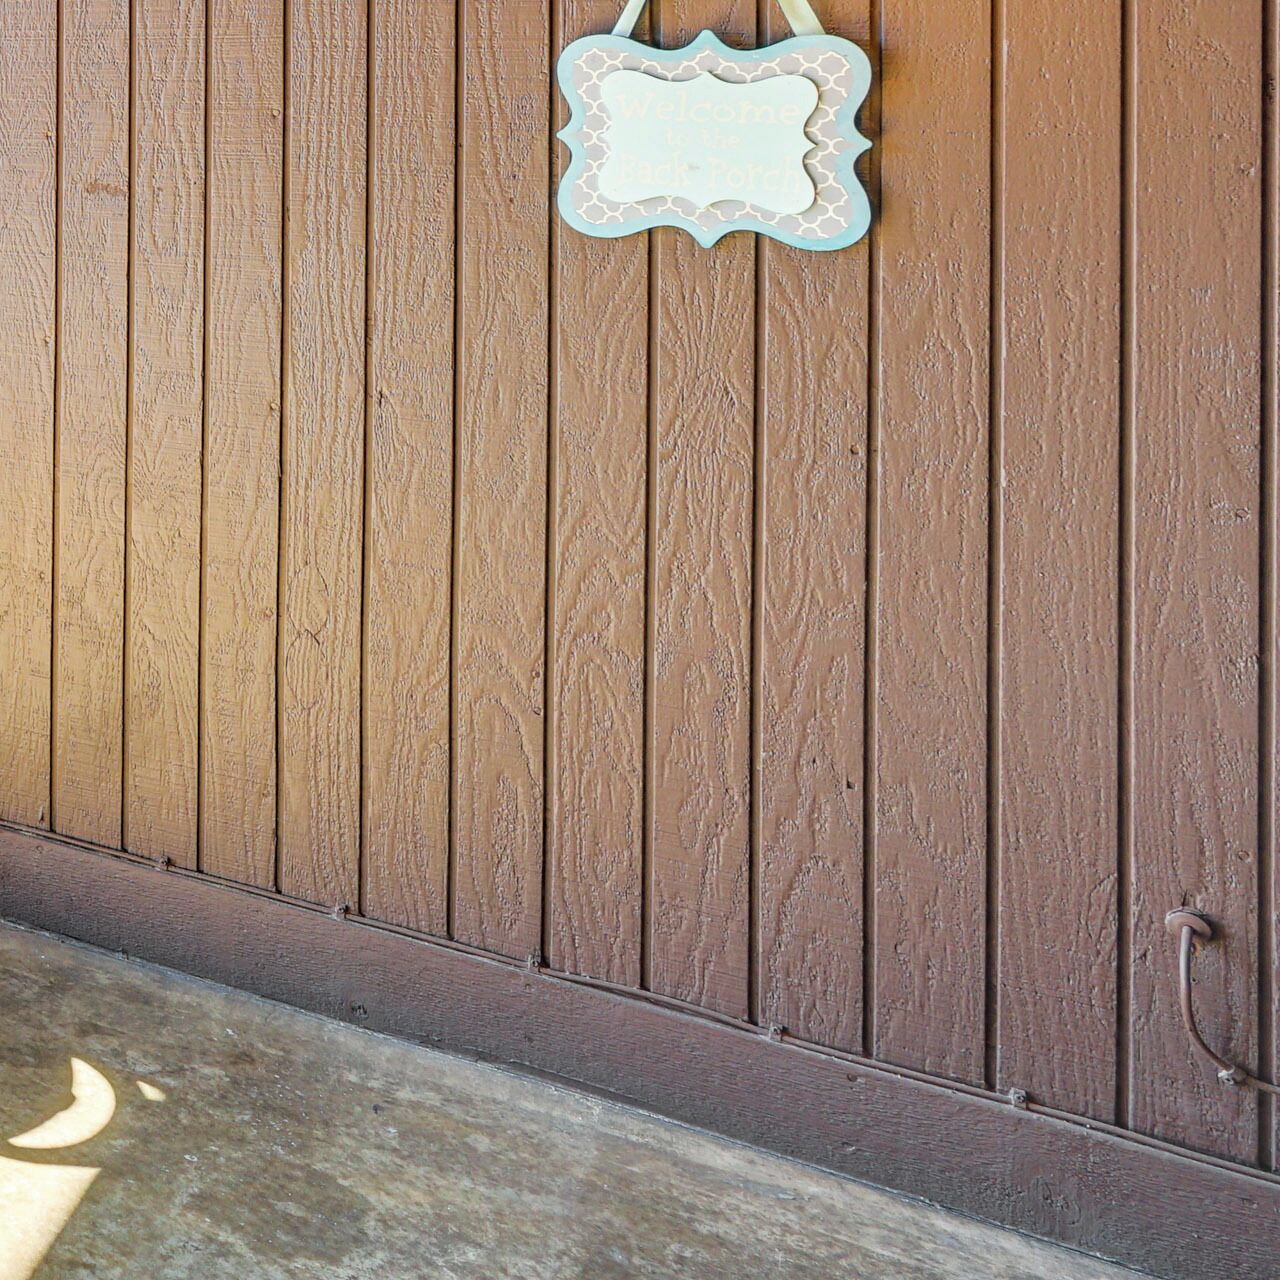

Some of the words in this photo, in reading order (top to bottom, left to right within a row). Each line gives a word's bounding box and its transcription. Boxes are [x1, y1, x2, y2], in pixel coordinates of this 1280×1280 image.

[618, 91, 802, 126] Welcome
[666, 128, 689, 148] to
[699, 128, 741, 149] the
[618, 150, 690, 186] Back
[706, 155, 801, 194] Porch
